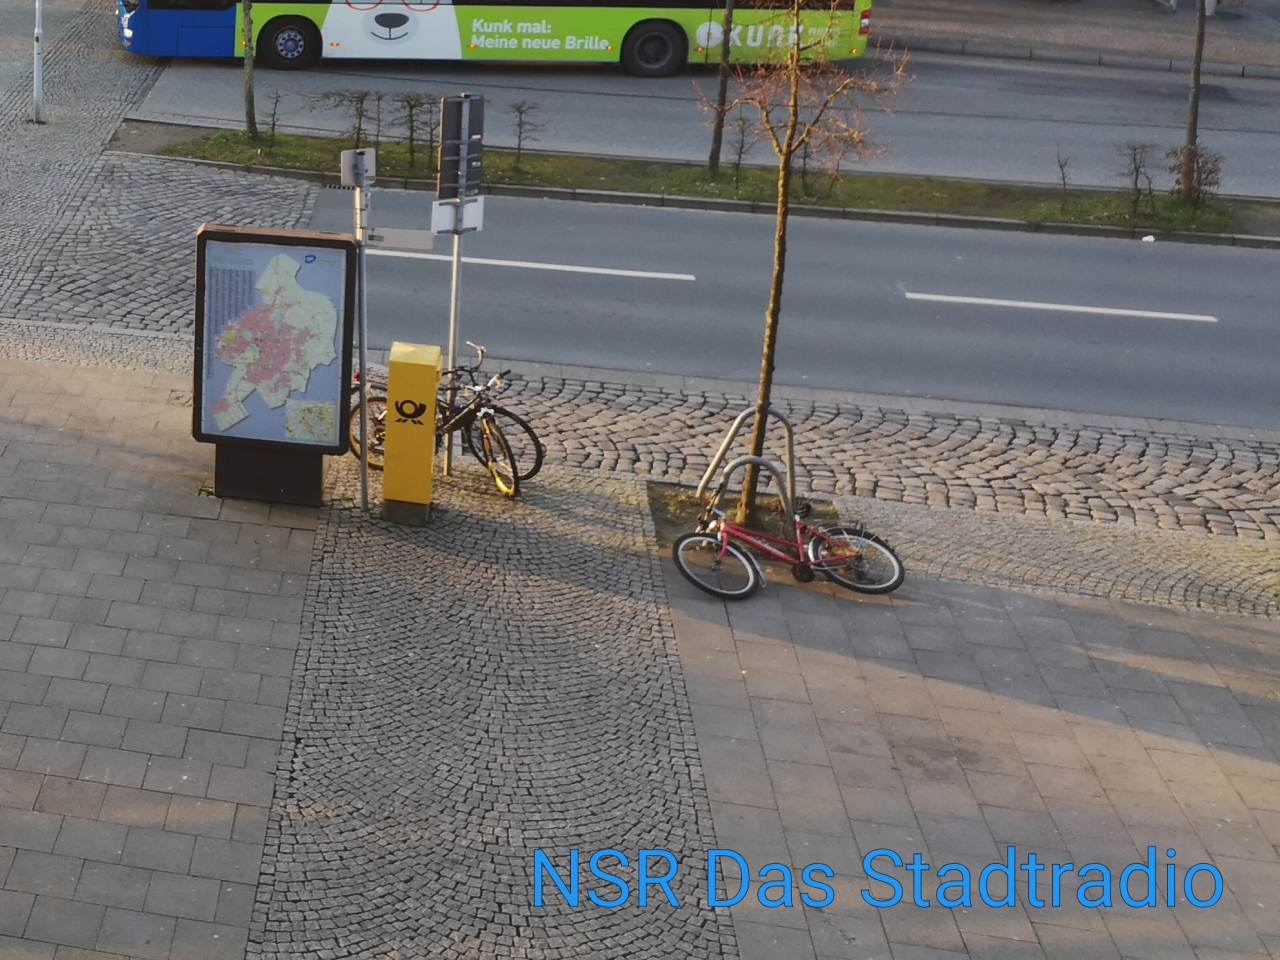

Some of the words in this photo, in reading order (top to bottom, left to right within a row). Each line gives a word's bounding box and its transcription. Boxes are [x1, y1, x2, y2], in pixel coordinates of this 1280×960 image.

[472, 18, 513, 33] Kunk
[517, 19, 552, 33] mal:
[471, 34, 518, 49] Meine
[522, 37, 561, 49] neue
[564, 35, 610, 50] Brille
